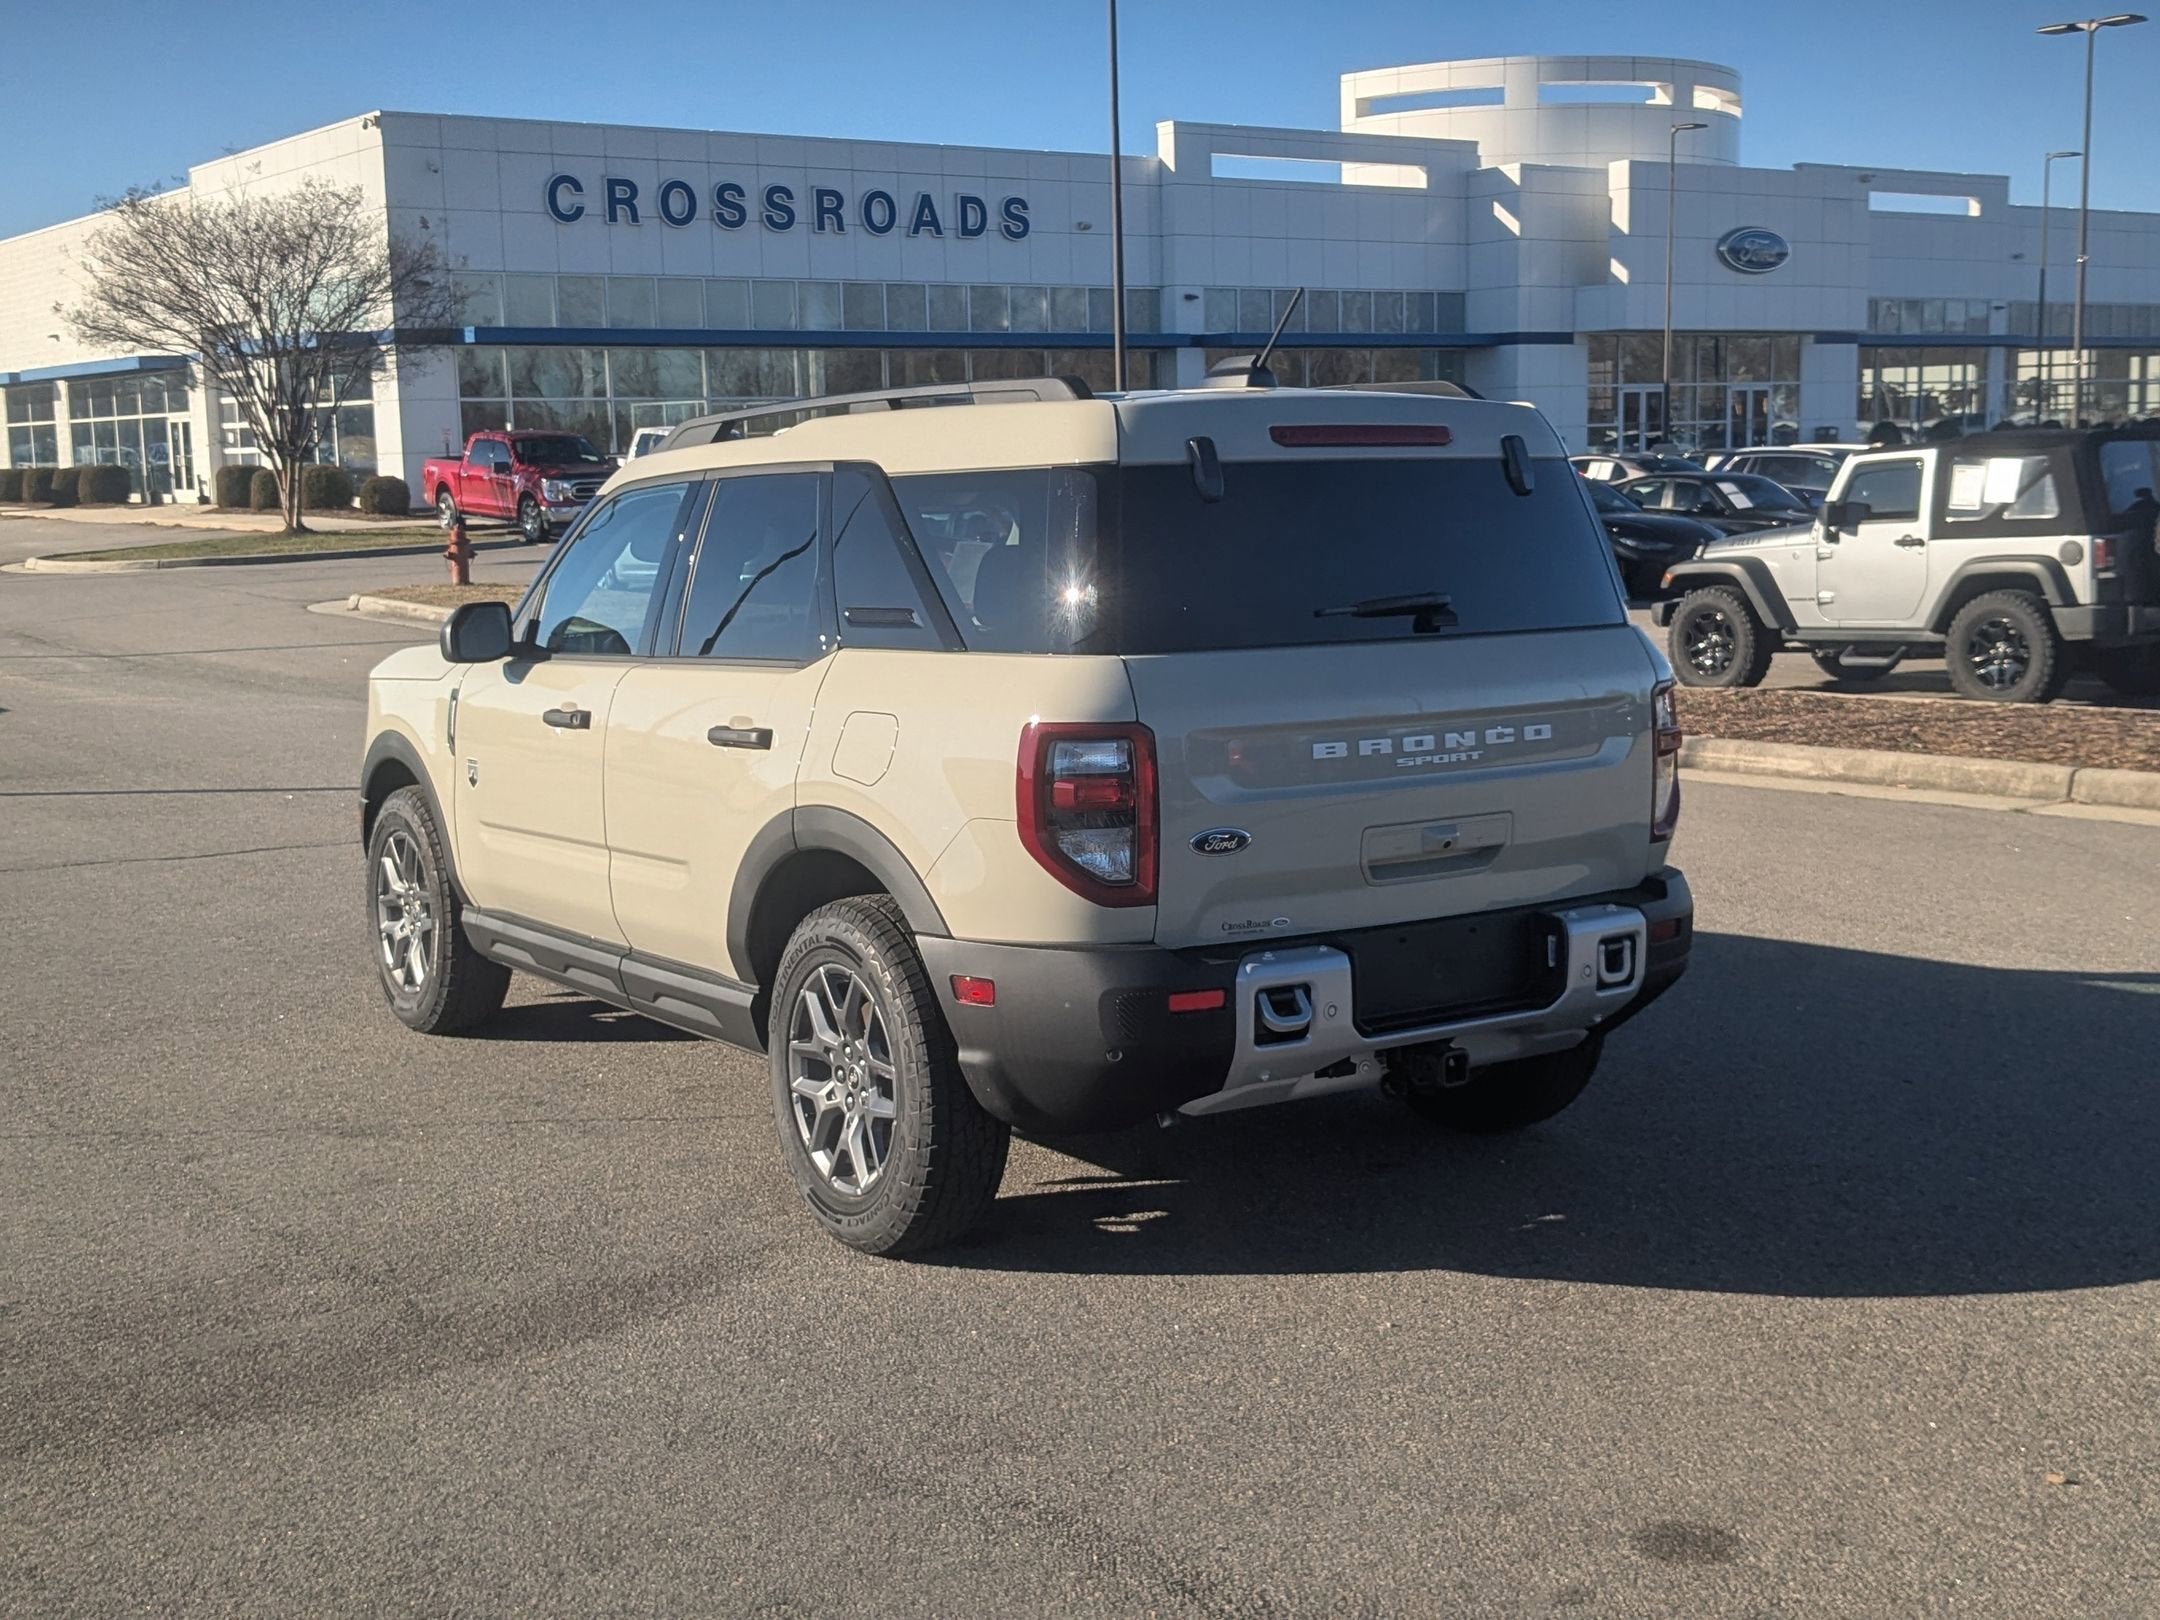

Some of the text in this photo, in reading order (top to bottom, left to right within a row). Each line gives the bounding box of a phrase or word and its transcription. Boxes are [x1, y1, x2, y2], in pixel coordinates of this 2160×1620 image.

[547, 174, 1031, 241] CROSSROADS
[1312, 724, 1552, 760] BRONCO
[1396, 751, 1484, 767] SPORT
[1205, 834, 1238, 851] Ford
